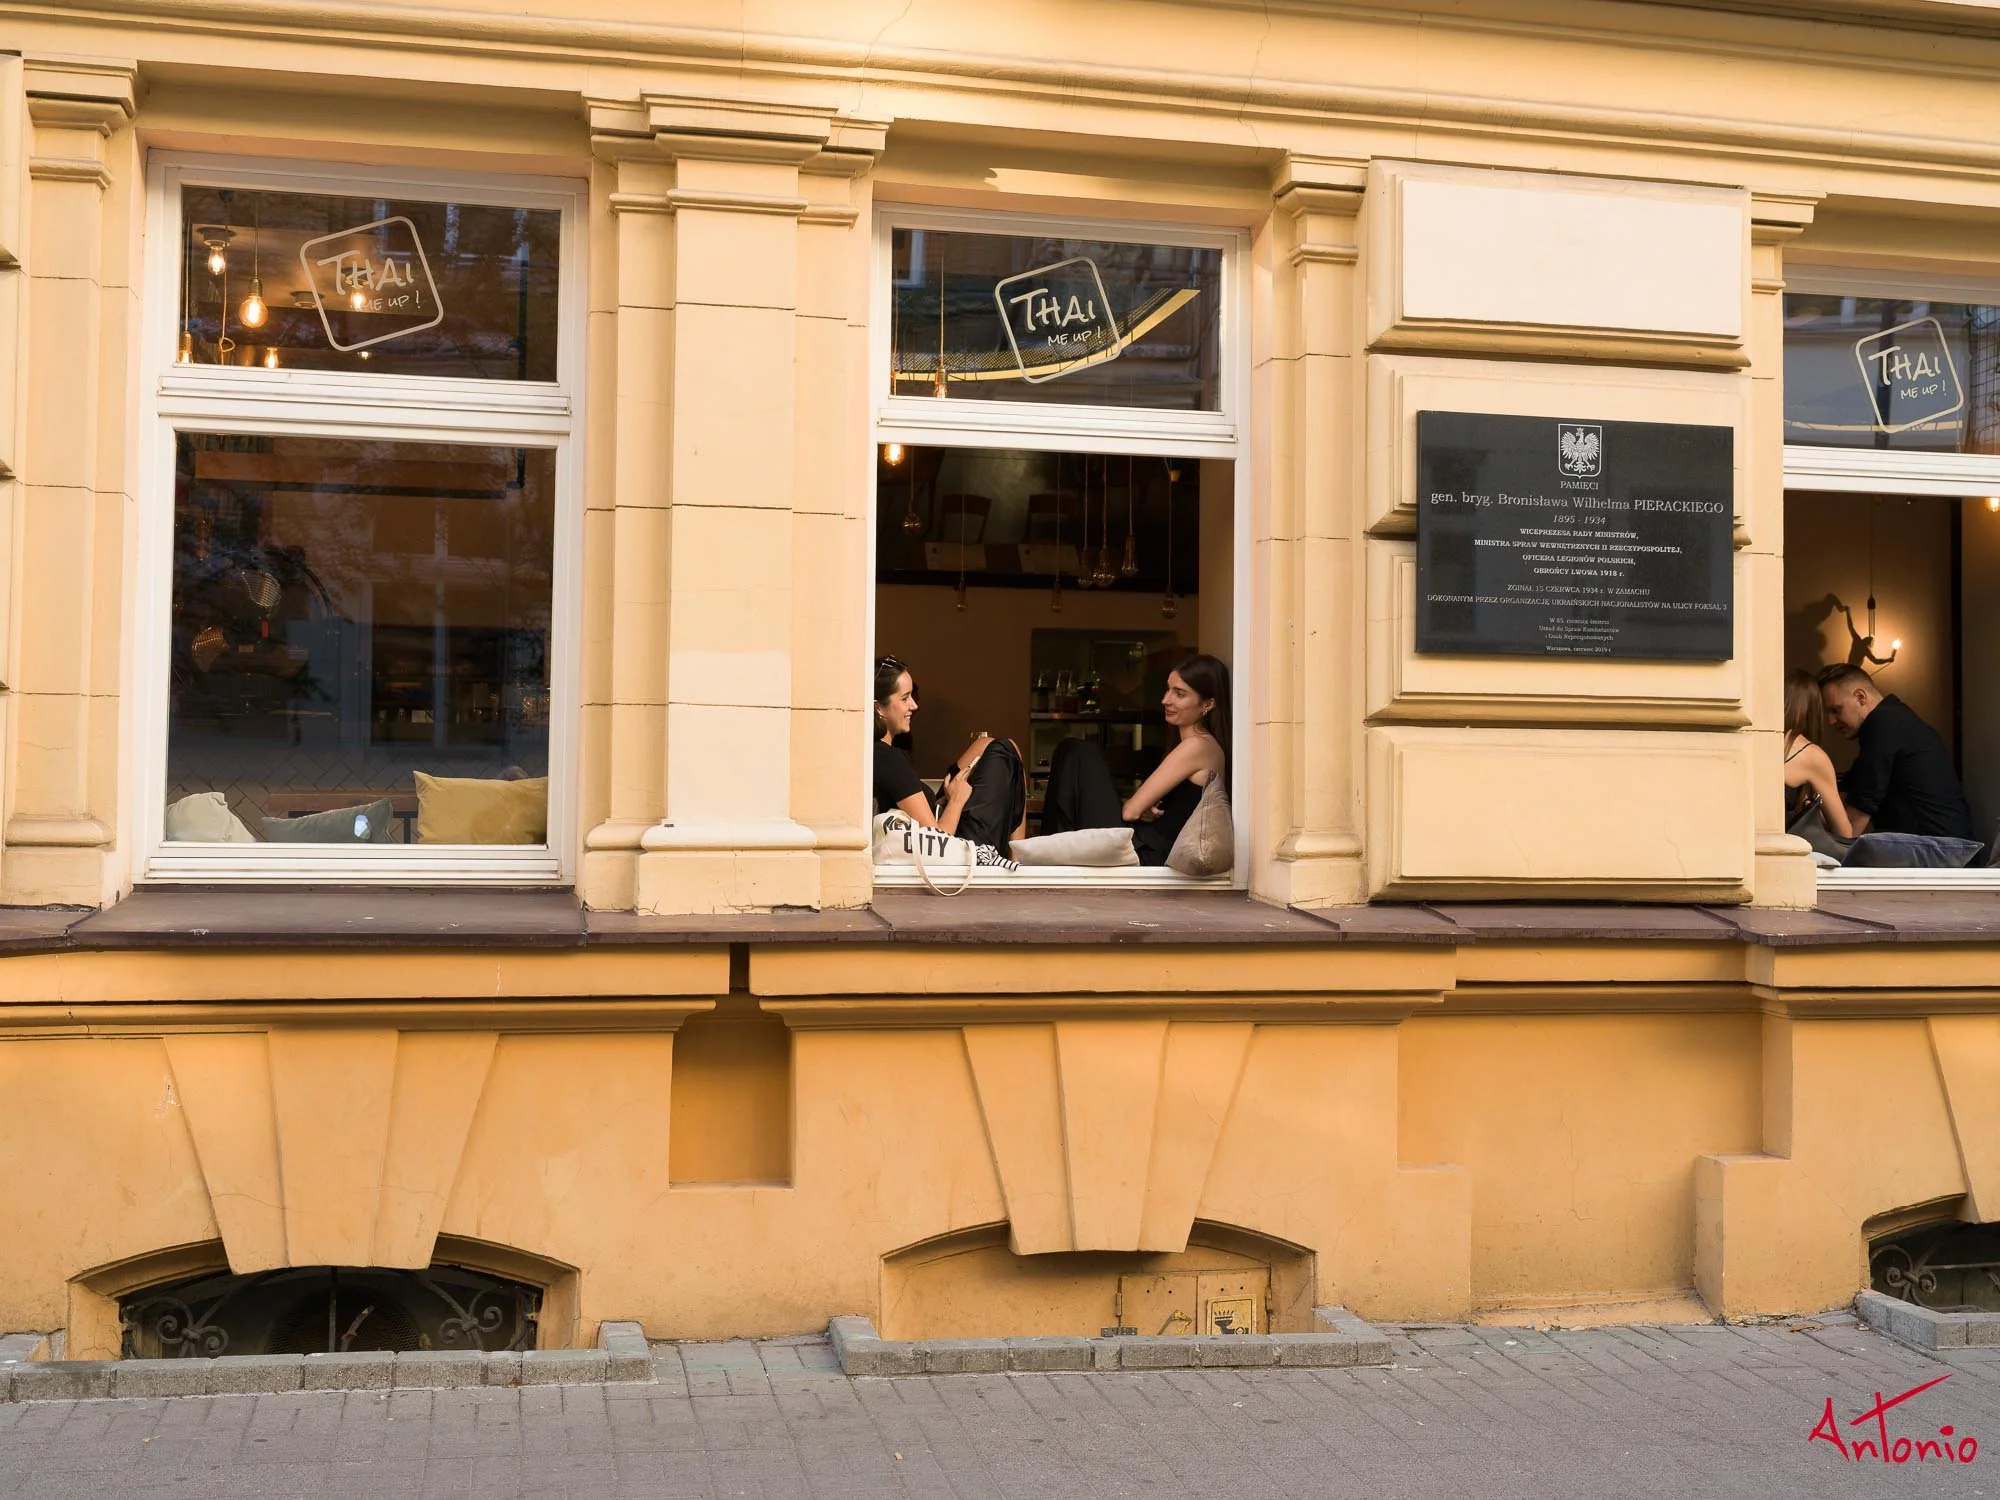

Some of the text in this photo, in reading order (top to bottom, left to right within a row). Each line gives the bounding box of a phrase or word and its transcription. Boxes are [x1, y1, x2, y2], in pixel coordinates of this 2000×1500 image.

[317, 250, 414, 295] THAI
[1009, 288, 1096, 332] THAI
[1047, 333, 1069, 347] ME
[1072, 330, 1092, 343] UP
[1868, 345, 1941, 386] THAI
[1900, 387, 1919, 400] ME
[1922, 384, 1938, 396] UP
[1430, 491, 1725, 514] gen. bryg. Bronisława Wilhelma PIERACKIEGO
[1552, 514, 1576, 524] 1895
[1583, 516, 1607, 525] 1934
[1519, 528, 1572, 537] WICEPREZESA
[1474, 539, 1511, 547] MINISTRA
[1512, 540, 1538, 548] SPRAW
[1522, 554, 1637, 566] OFICERA LEGIONÓW POLSKICH,
[1533, 566, 1570, 575] OBROŃCY
[1600, 569, 1618, 577] 1918
[1615, 588, 1651, 596] ZAMACHU
[1427, 594, 1474, 603] DOKONANYM
[1475, 596, 1498, 604] PRZEZ
[1672, 602, 1693, 610] ULICY
[1693, 603, 1722, 611] FOKSAL
